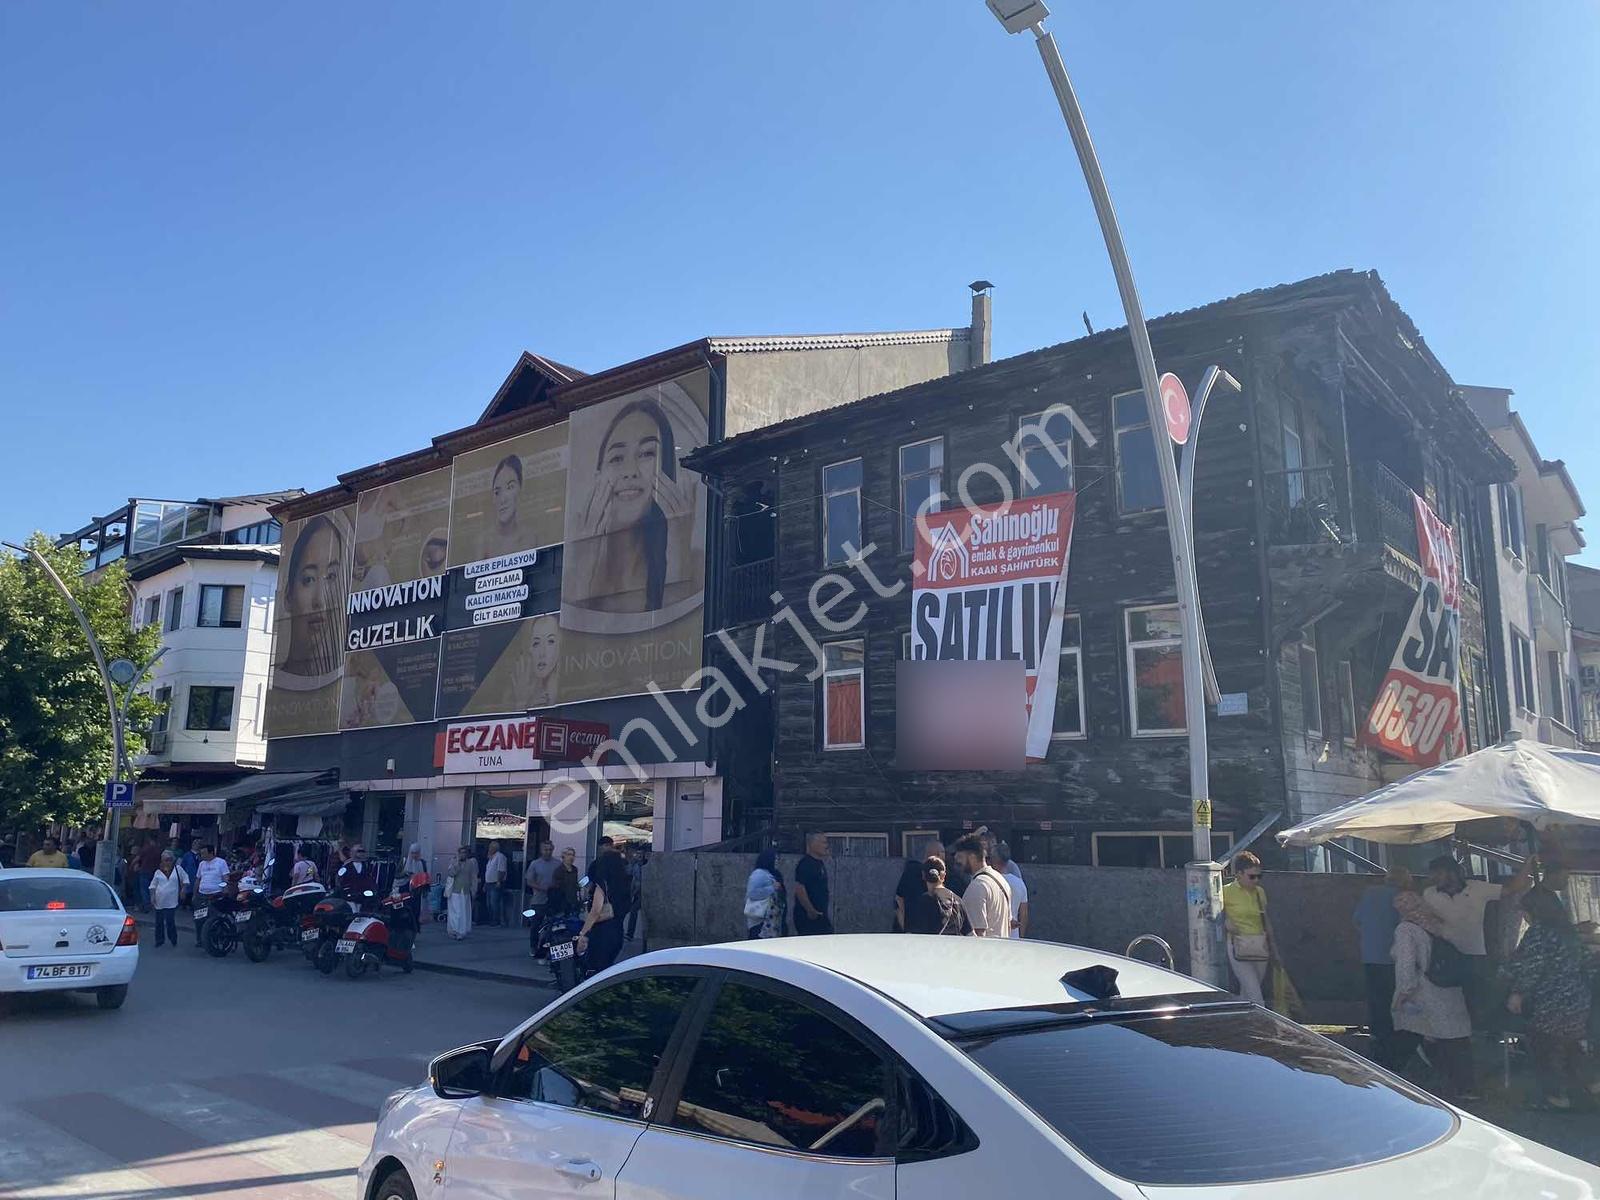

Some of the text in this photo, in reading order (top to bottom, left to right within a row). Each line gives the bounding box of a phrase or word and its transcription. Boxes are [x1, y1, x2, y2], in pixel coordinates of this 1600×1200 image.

[970, 504, 1059, 551] Şahinoğlu
[971, 538, 1059, 562] emlak & gayrimenkul
[466, 552, 535, 576] LAZER EPİLASYON
[971, 557, 1059, 577] KAAN ŞAHİNTÜRK
[477, 572, 521, 590] ZAYIFLAMA
[347, 575, 442, 615] INNOVATION
[467, 587, 527, 607] KALICI MAKYAJ
[474, 605, 521, 622] CİLT BAKIMI
[564, 639, 693, 673] INNOVATION
[1369, 679, 1452, 754] 0530
[447, 722, 536, 754] ECZANE
[479, 755, 503, 767] TUNA
[112, 784, 127, 800] P
[35, 965, 89, 977] 74 BF 817
